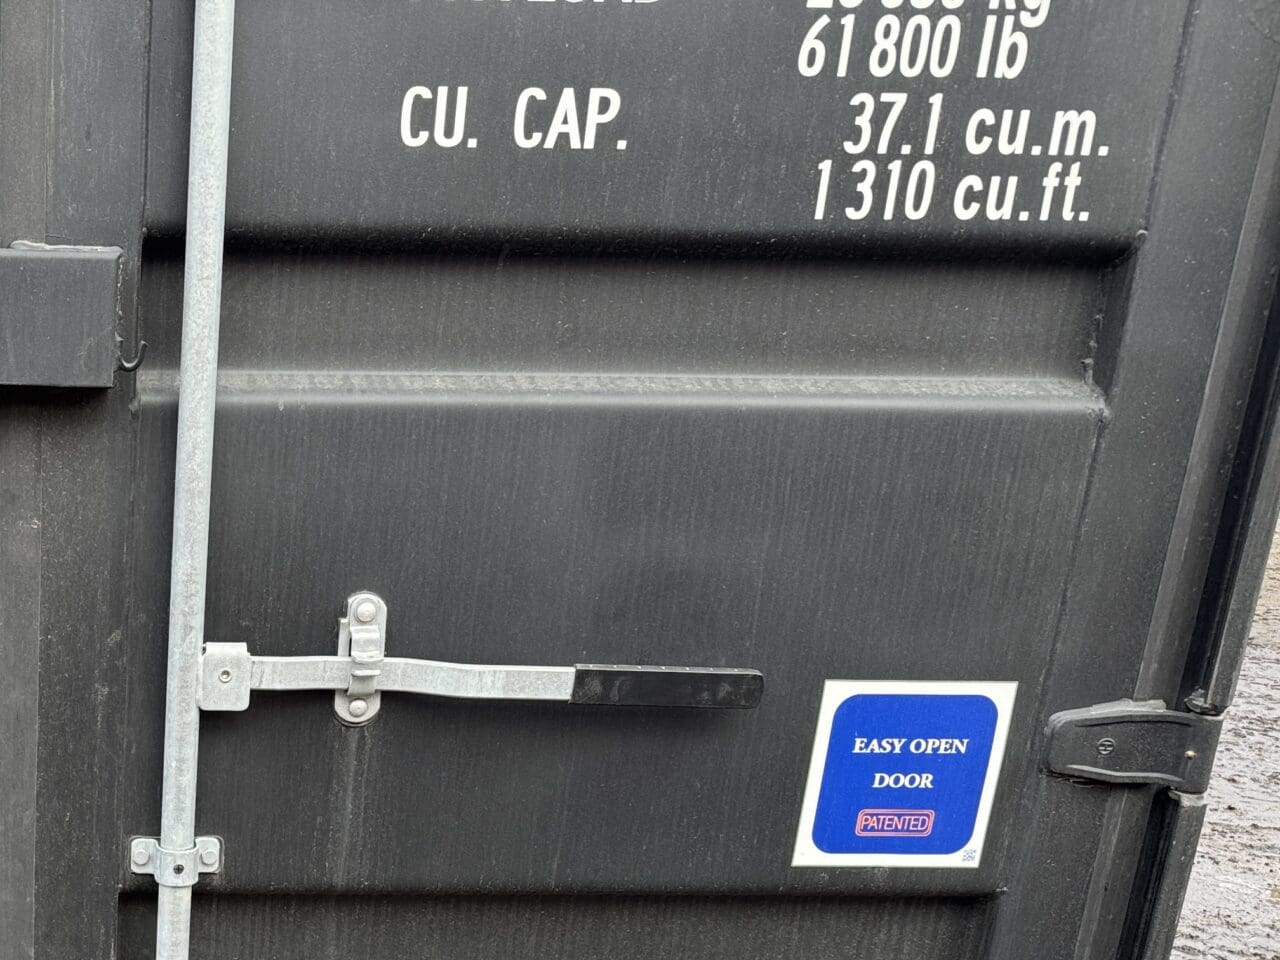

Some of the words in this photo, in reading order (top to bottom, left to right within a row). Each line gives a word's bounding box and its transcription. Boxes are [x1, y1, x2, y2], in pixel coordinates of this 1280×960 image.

[976, 14, 1029, 79] lb
[400, 86, 478, 149] CU.
[513, 87, 628, 150] CAP.
[843, 93, 944, 155] 37.1
[966, 107, 1109, 157] cu.m.
[954, 161, 1090, 222] cu.ft.
[852, 738, 907, 754] EASY
[909, 738, 970, 754] OPEN
[871, 773, 934, 789] DOOR
[860, 815, 929, 831] PATENTED
